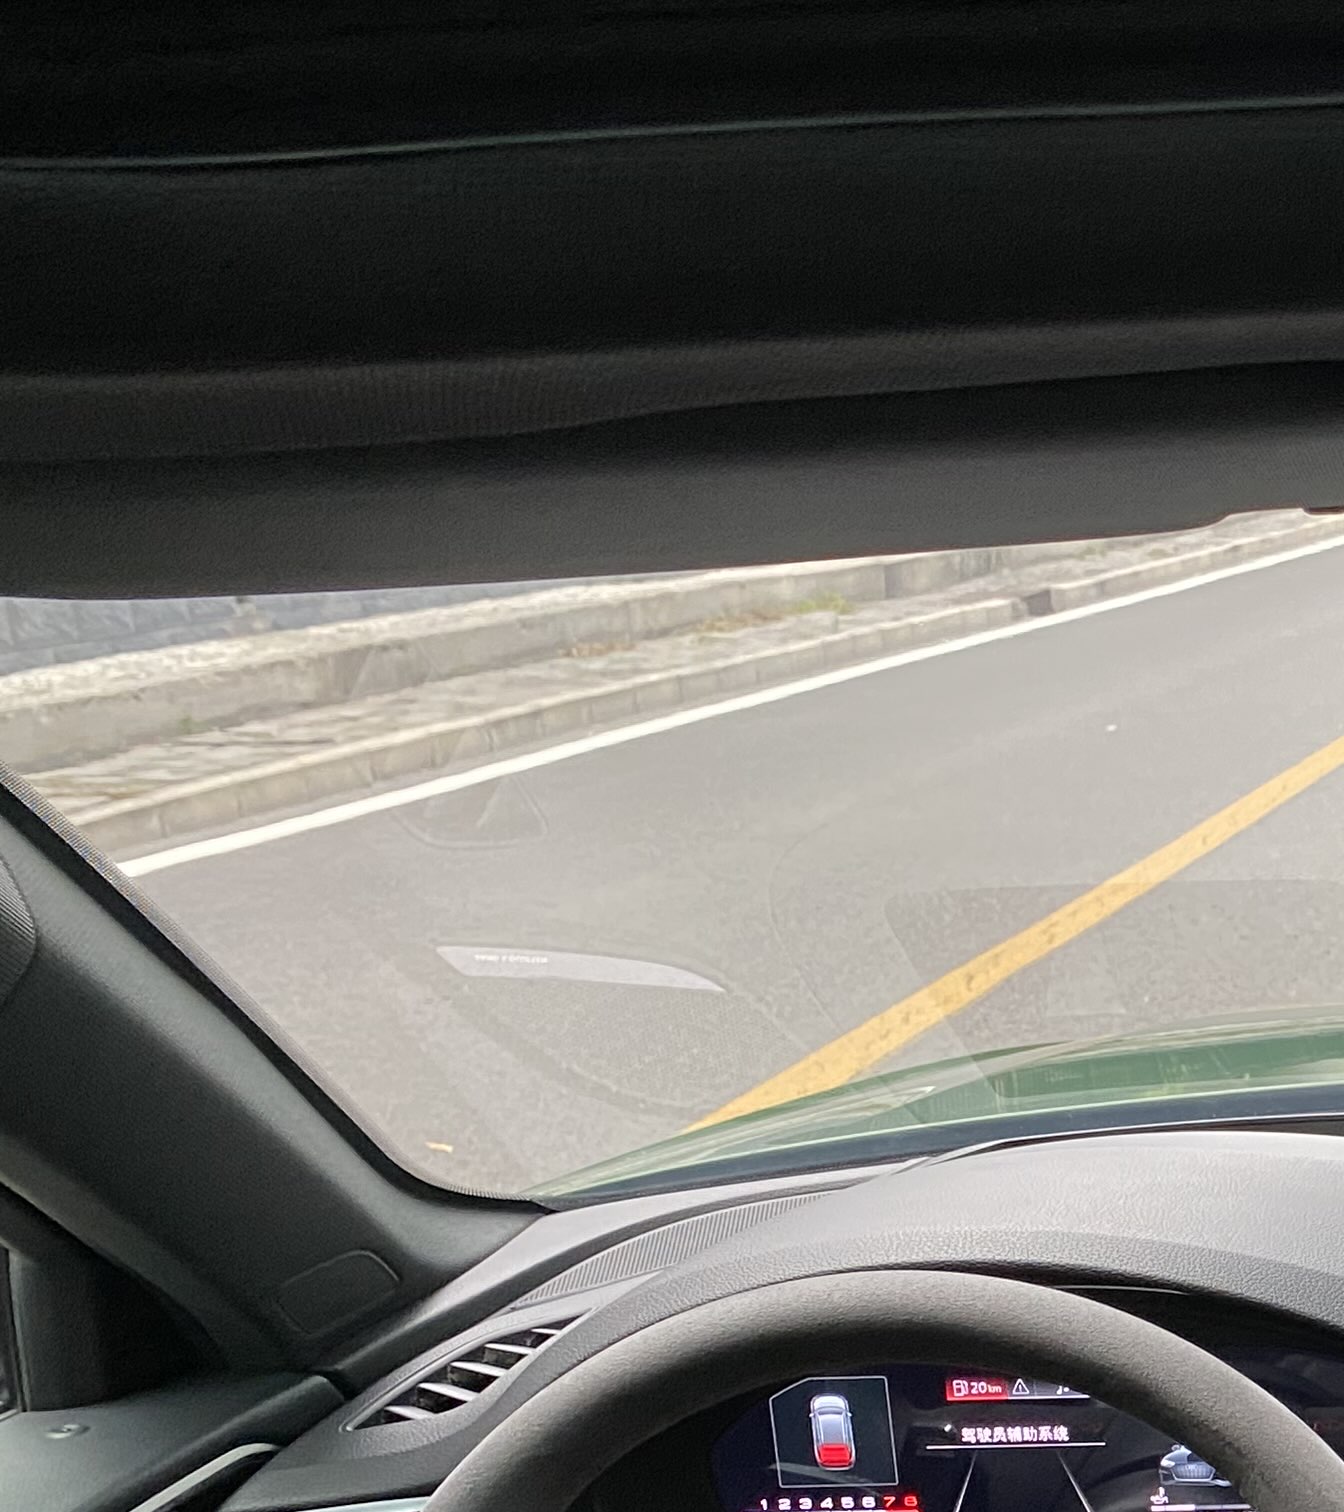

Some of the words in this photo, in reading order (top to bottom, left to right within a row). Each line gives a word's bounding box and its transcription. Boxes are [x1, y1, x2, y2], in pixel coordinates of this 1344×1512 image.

[961, 1425, 1070, 1443] 驾驶员辅助系统
[760, 1498, 768, 1511] 1
[778, 1498, 792, 1511] 2
[798, 1497, 813, 1510] 3
[820, 1497, 834, 1509] 4
[841, 1496, 855, 1509] 5
[861, 1496, 876, 1509] 6
[883, 1496, 896, 1507] 7
